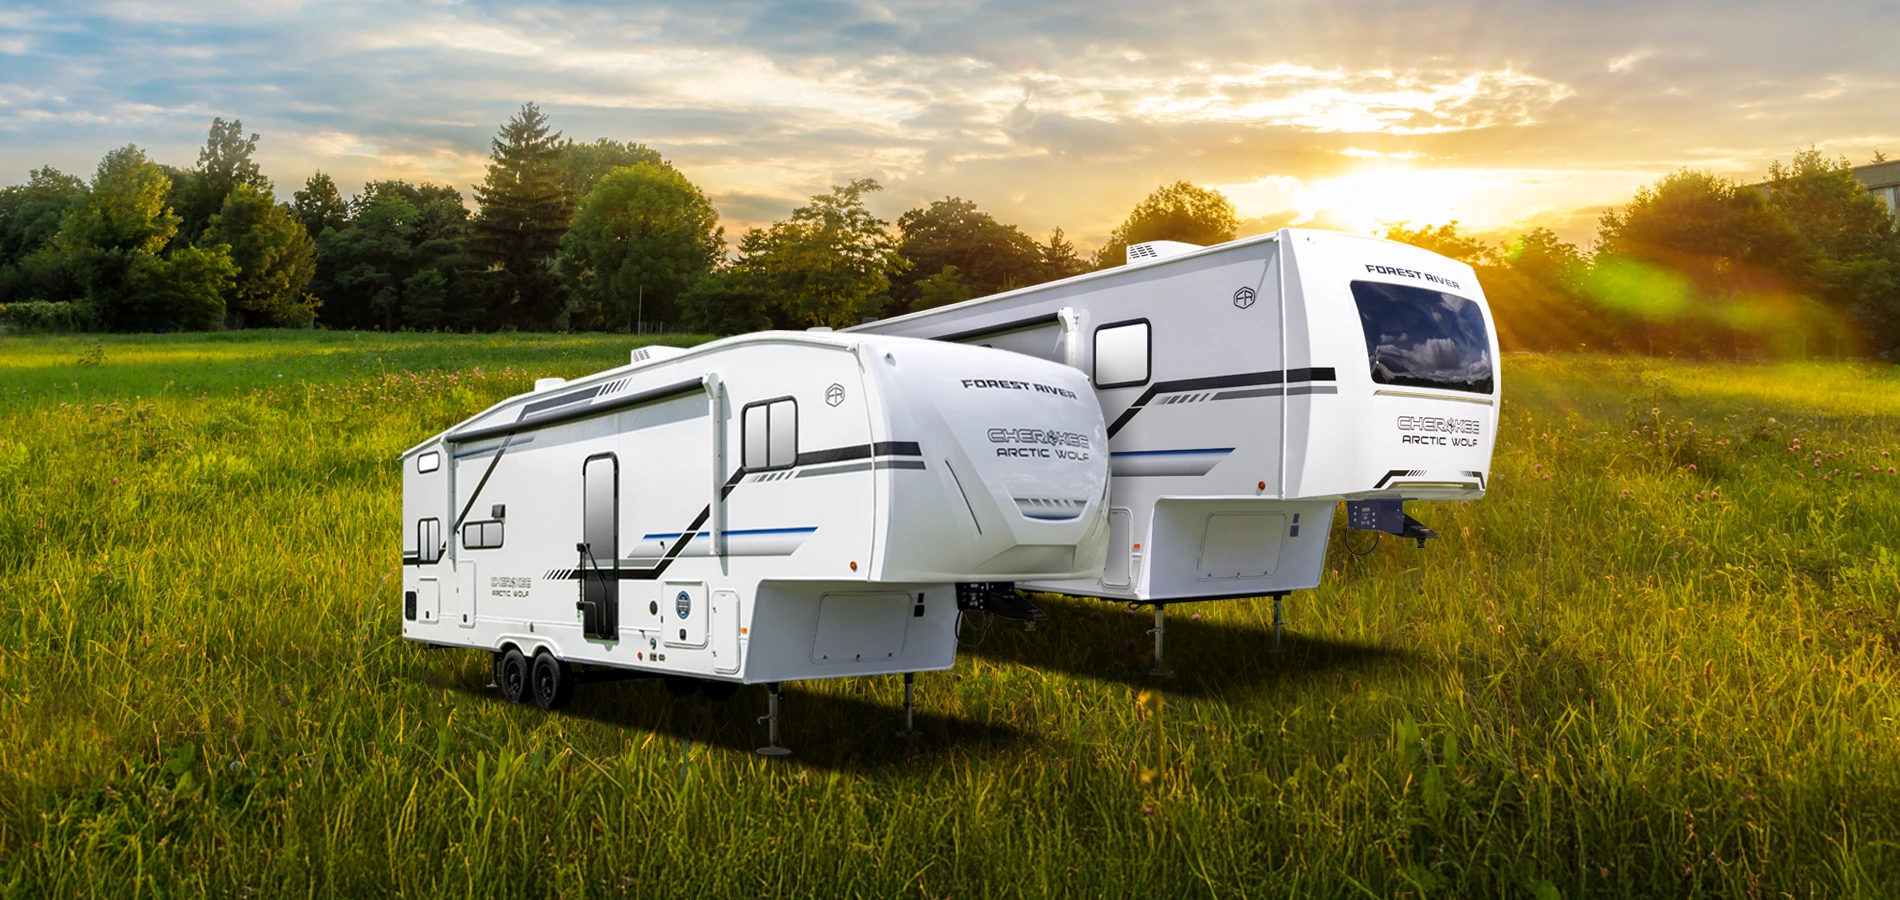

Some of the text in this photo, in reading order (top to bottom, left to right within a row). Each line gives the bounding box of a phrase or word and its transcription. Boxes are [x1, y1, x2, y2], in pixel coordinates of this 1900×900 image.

[1365, 264, 1461, 290] FOREST RIVER
[960, 379, 1077, 400] FOREST RIVER
[1402, 435, 1478, 447] ARCTIC WOLF
[996, 447, 1090, 462] ARCTIC WOLF
